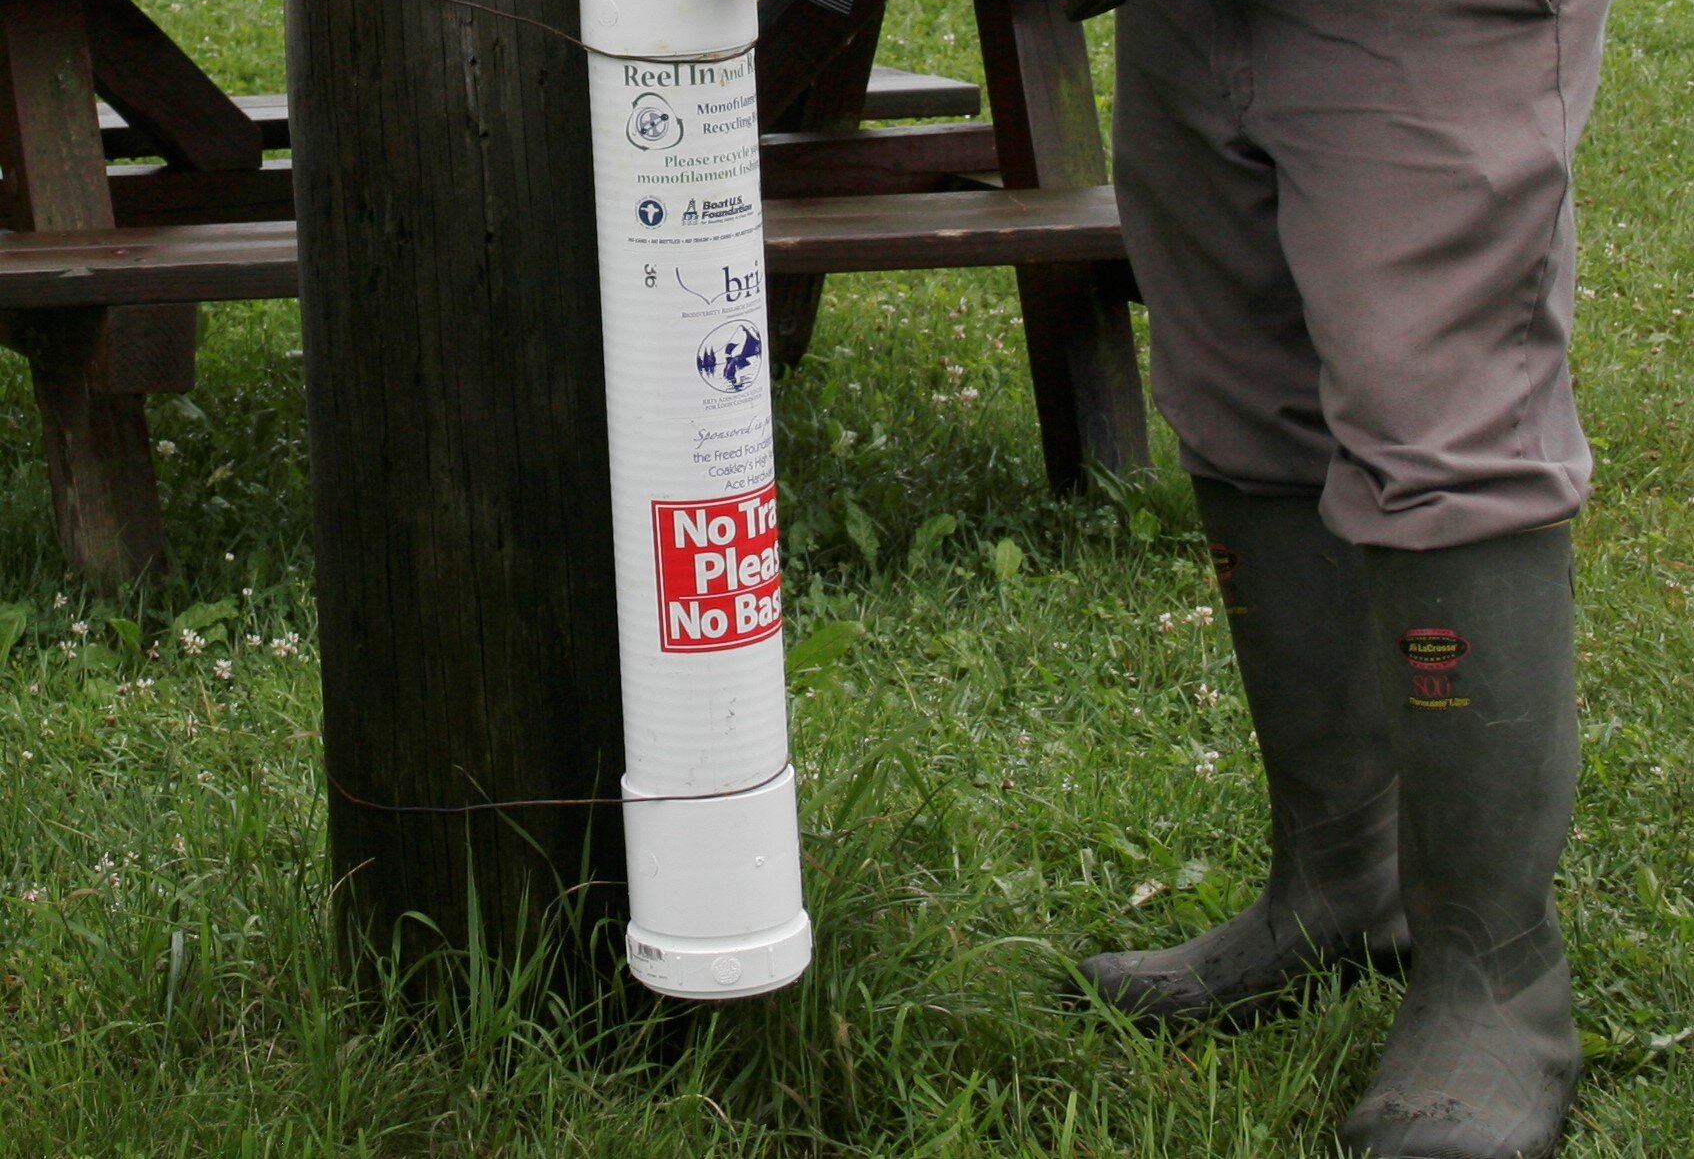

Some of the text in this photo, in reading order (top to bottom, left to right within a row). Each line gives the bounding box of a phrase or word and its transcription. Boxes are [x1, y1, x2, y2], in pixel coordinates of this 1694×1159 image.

[624, 62, 681, 87] Reel
[690, 64, 716, 86] In
[720, 61, 744, 82] And
[703, 116, 752, 135] Recycling
[664, 154, 710, 168] Please
[713, 146, 749, 163] recycle
[637, 167, 737, 185] monofilament
[701, 203, 752, 220] Foundation
[693, 416, 757, 449] Sponsored
[693, 452, 711, 463] the
[715, 446, 742, 461] Freed
[725, 479, 745, 491] Ace
[672, 497, 777, 549] No Tra
[669, 587, 781, 641] No Bas
[1418, 643, 1458, 653] LaCrosse
